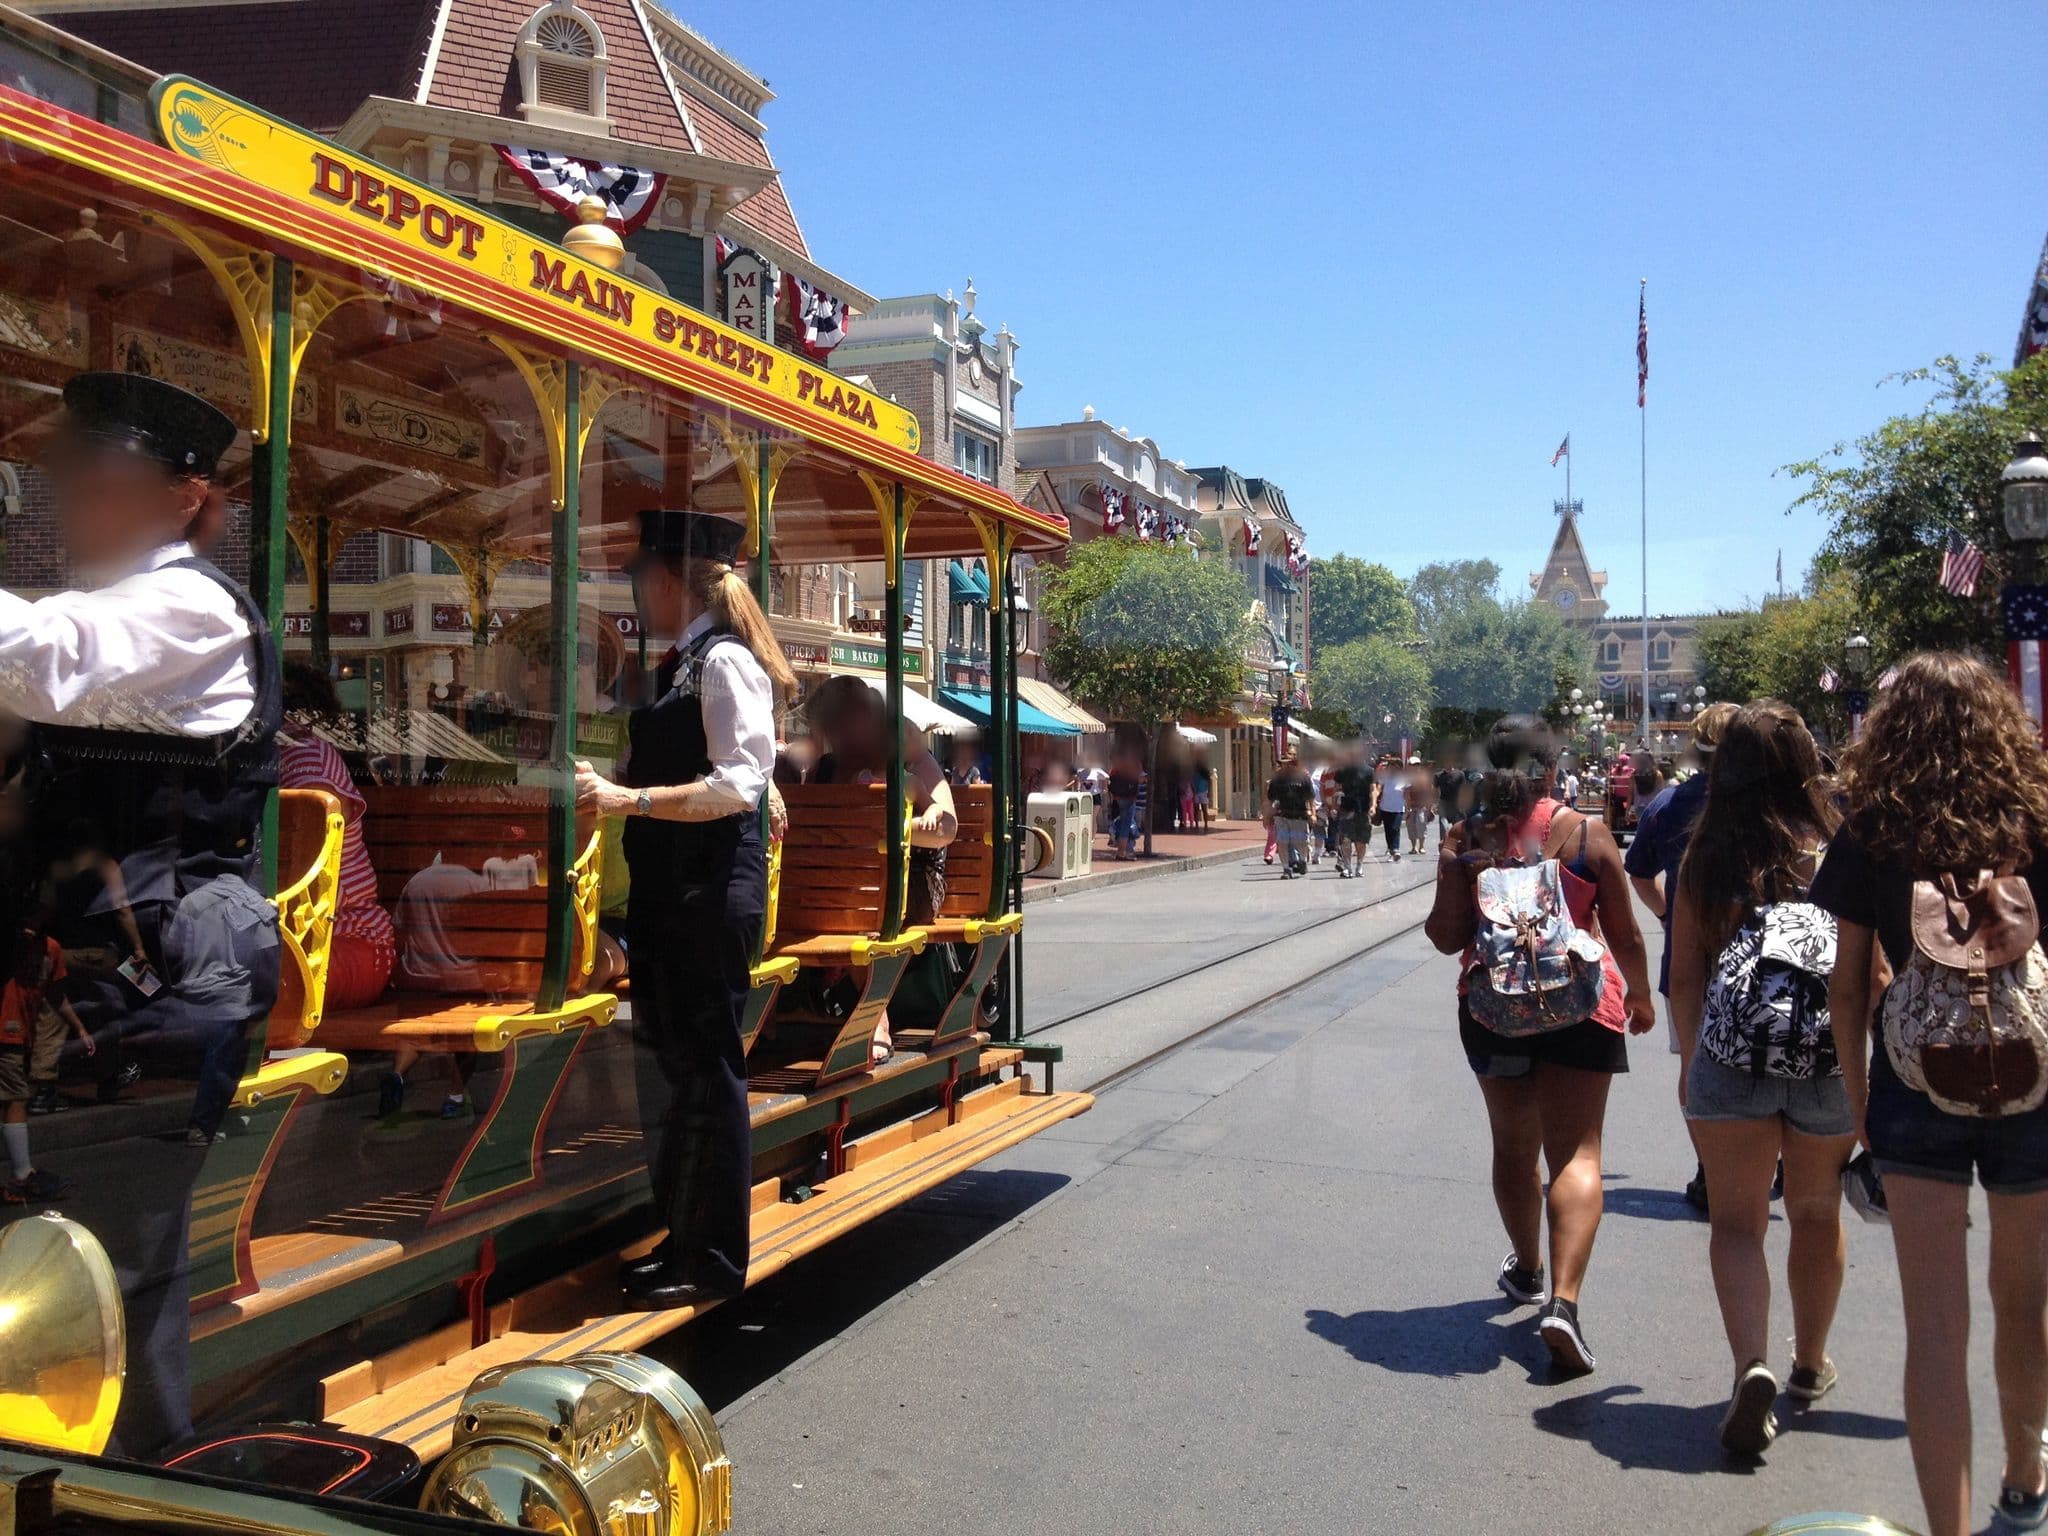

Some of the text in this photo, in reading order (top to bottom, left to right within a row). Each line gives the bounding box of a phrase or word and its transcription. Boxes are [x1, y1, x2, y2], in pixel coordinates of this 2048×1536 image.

[310, 152, 878, 430] DEPOT MAIN STREET PLAZA
[733, 271, 756, 330] MAR
[393, 613, 407, 629] TEA
[784, 644, 816, 659] SPICES
[852, 650, 879, 664] BAKED
